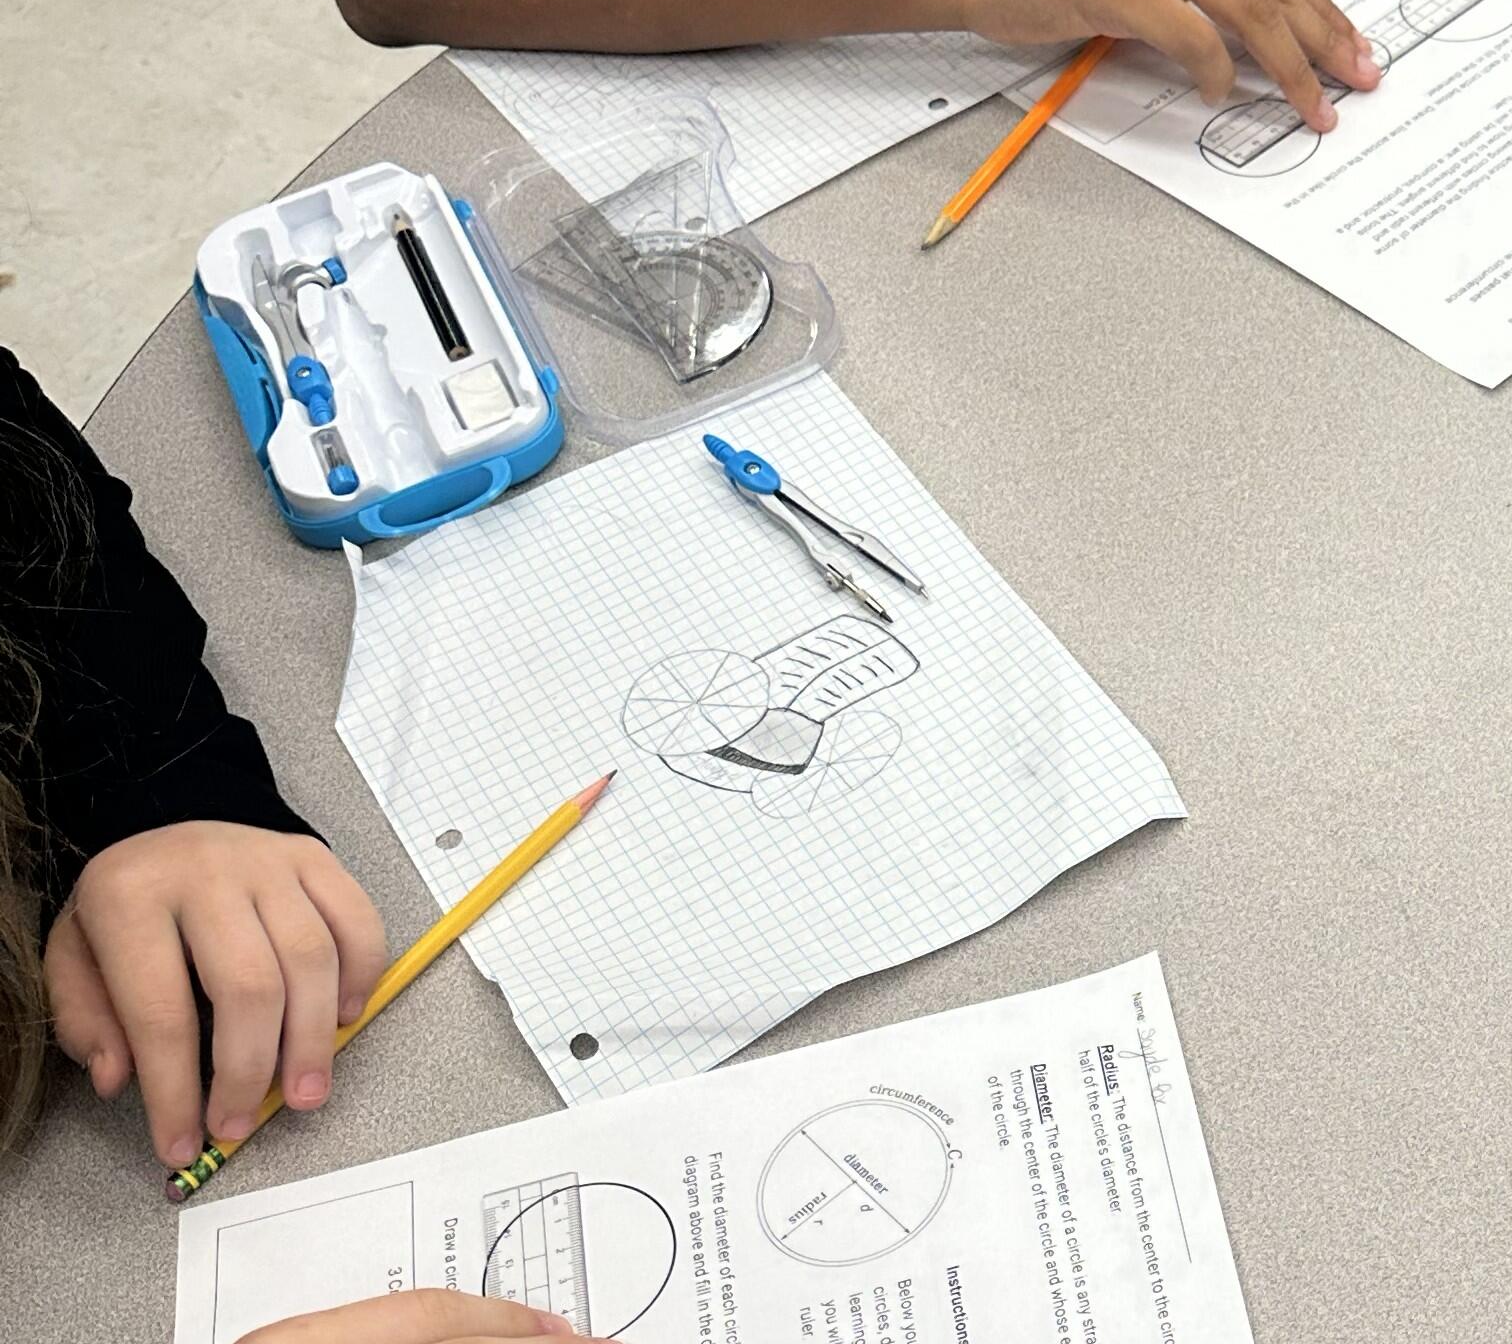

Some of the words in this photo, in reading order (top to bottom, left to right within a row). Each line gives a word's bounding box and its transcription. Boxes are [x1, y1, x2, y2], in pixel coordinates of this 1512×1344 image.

[1077, 1049, 1096, 1074] half
[1096, 1043, 1121, 1097] Radius:
[987, 1075, 1004, 1089] of
[1009, 1068, 1031, 1117] through
[1029, 1063, 1055, 1126] Diameter:
[1083, 1075, 1099, 1089] of
[868, 1083, 956, 1127] circumference
[989, 1090, 1005, 1112] the
[1086, 1090, 1101, 1112] the
[1112, 1095, 1127, 1121] The
[1018, 1117, 1034, 1140] the
[1044, 1123, 1061, 1150] The
[1090, 1113, 1112, 1156] circle's
[1023, 1141, 1041, 1180] center
[1116, 1123, 1138, 1176] distance
[707, 1151, 726, 1181] Find
[842, 1152, 890, 1195] diameter
[1049, 1151, 1071, 1206] diameter
[681, 1155, 700, 1209] diagram
[711, 1181, 727, 1205] the
[1031, 1183, 1048, 1197] of
[1129, 1177, 1145, 1209] from
[786, 1190, 829, 1225] radius
[1033, 1198, 1049, 1221] the
[1060, 1209, 1078, 1224] of
[1136, 1209, 1151, 1233] the
[443, 1217, 459, 1251] Draw
[688, 1210, 705, 1251] above
[712, 1206, 732, 1264] diameter
[1038, 1222, 1057, 1259] circle
[1064, 1226, 1076, 1236] a
[444, 1254, 457, 1264] a
[692, 1252, 711, 1278] and
[1066, 1237, 1086, 1274] circle
[1140, 1234, 1161, 1276] center
[387, 1266, 403, 1277] 3
[444, 1264, 460, 1295] circ
[719, 1266, 737, 1281] of
[1045, 1260, 1064, 1286] and
[1073, 1274, 1088, 1289] is
[695, 1279, 712, 1297] fill
[897, 1278, 915, 1320] Below
[1151, 1277, 1164, 1294] to
[696, 1297, 712, 1312] in
[720, 1283, 739, 1317] each
[819, 1298, 838, 1325] you
[872, 1285, 892, 1335] circles,
[1050, 1287, 1069, 1334] whose
[1075, 1290, 1092, 1315] any
[1154, 1294, 1171, 1320] the
[698, 1313, 715, 1337] the
